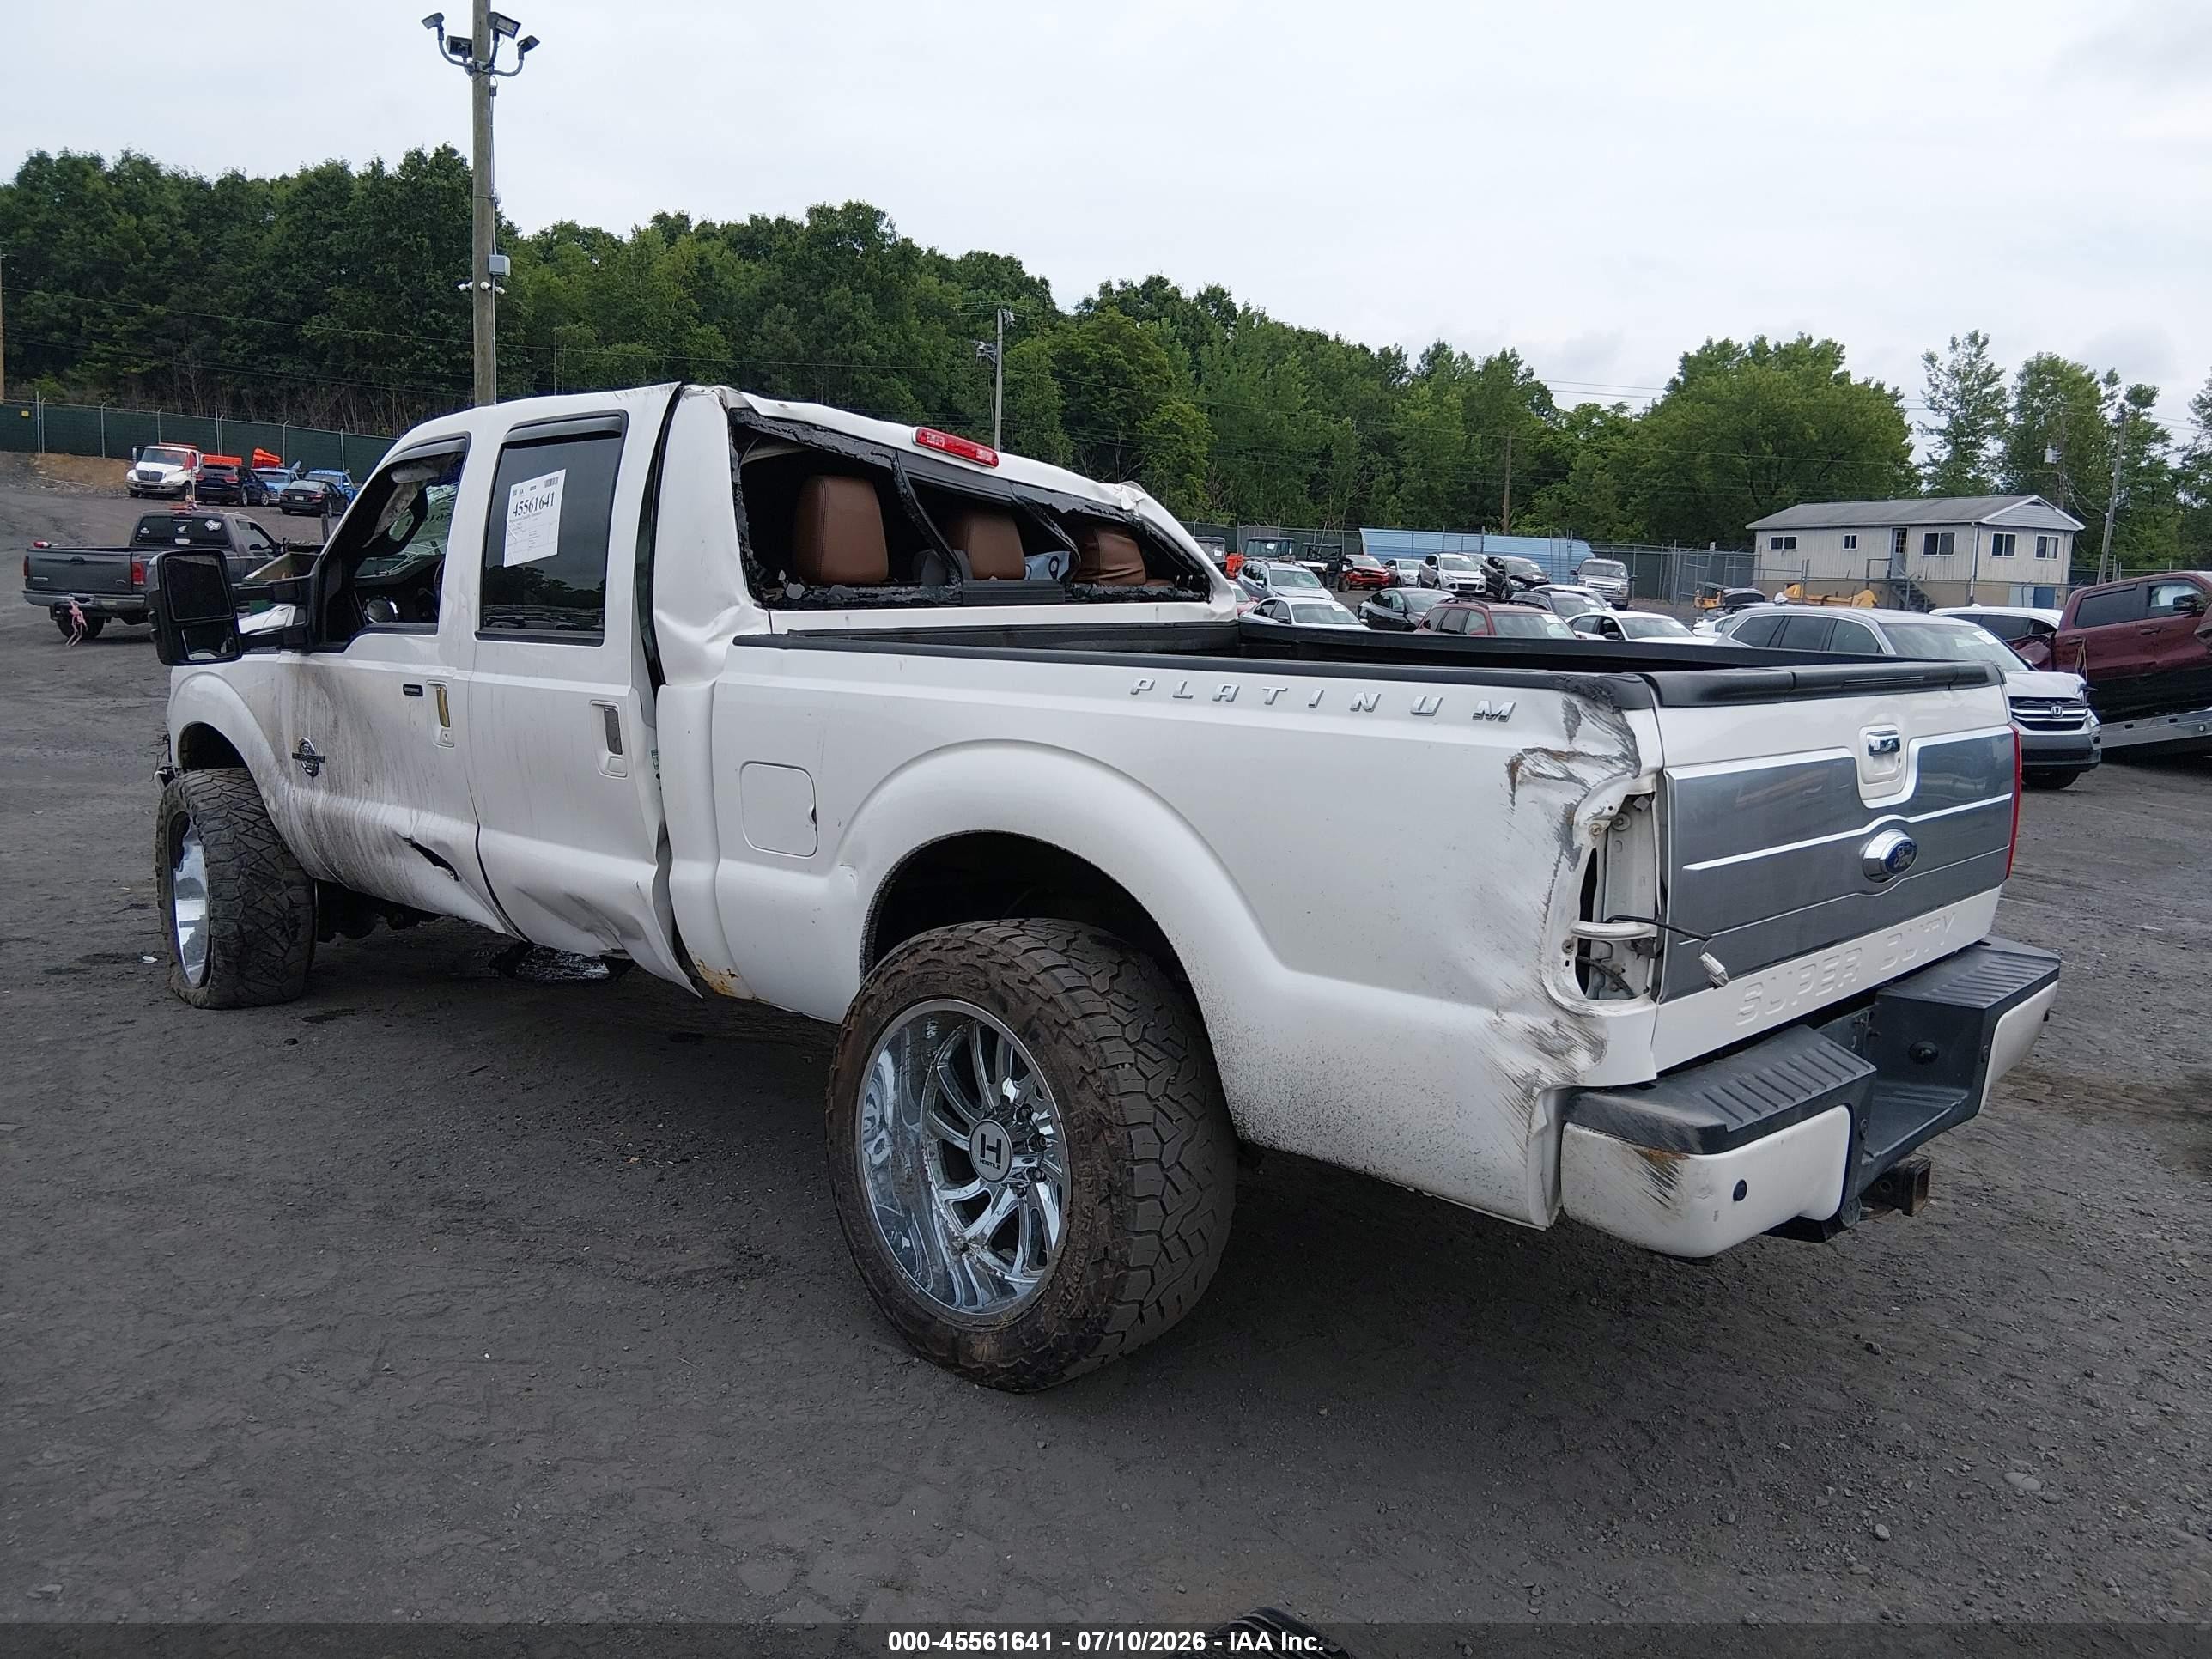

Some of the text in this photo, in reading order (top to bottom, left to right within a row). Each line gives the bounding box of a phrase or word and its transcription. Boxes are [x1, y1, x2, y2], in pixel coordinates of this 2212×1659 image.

[513, 491, 555, 517] 45561641
[1129, 678, 1516, 723] PLATINUM
[1735, 947, 1863, 1026] SUPER
[979, 1158, 1001, 1170] HOSTILE
[980, 1133, 1002, 1164] H
